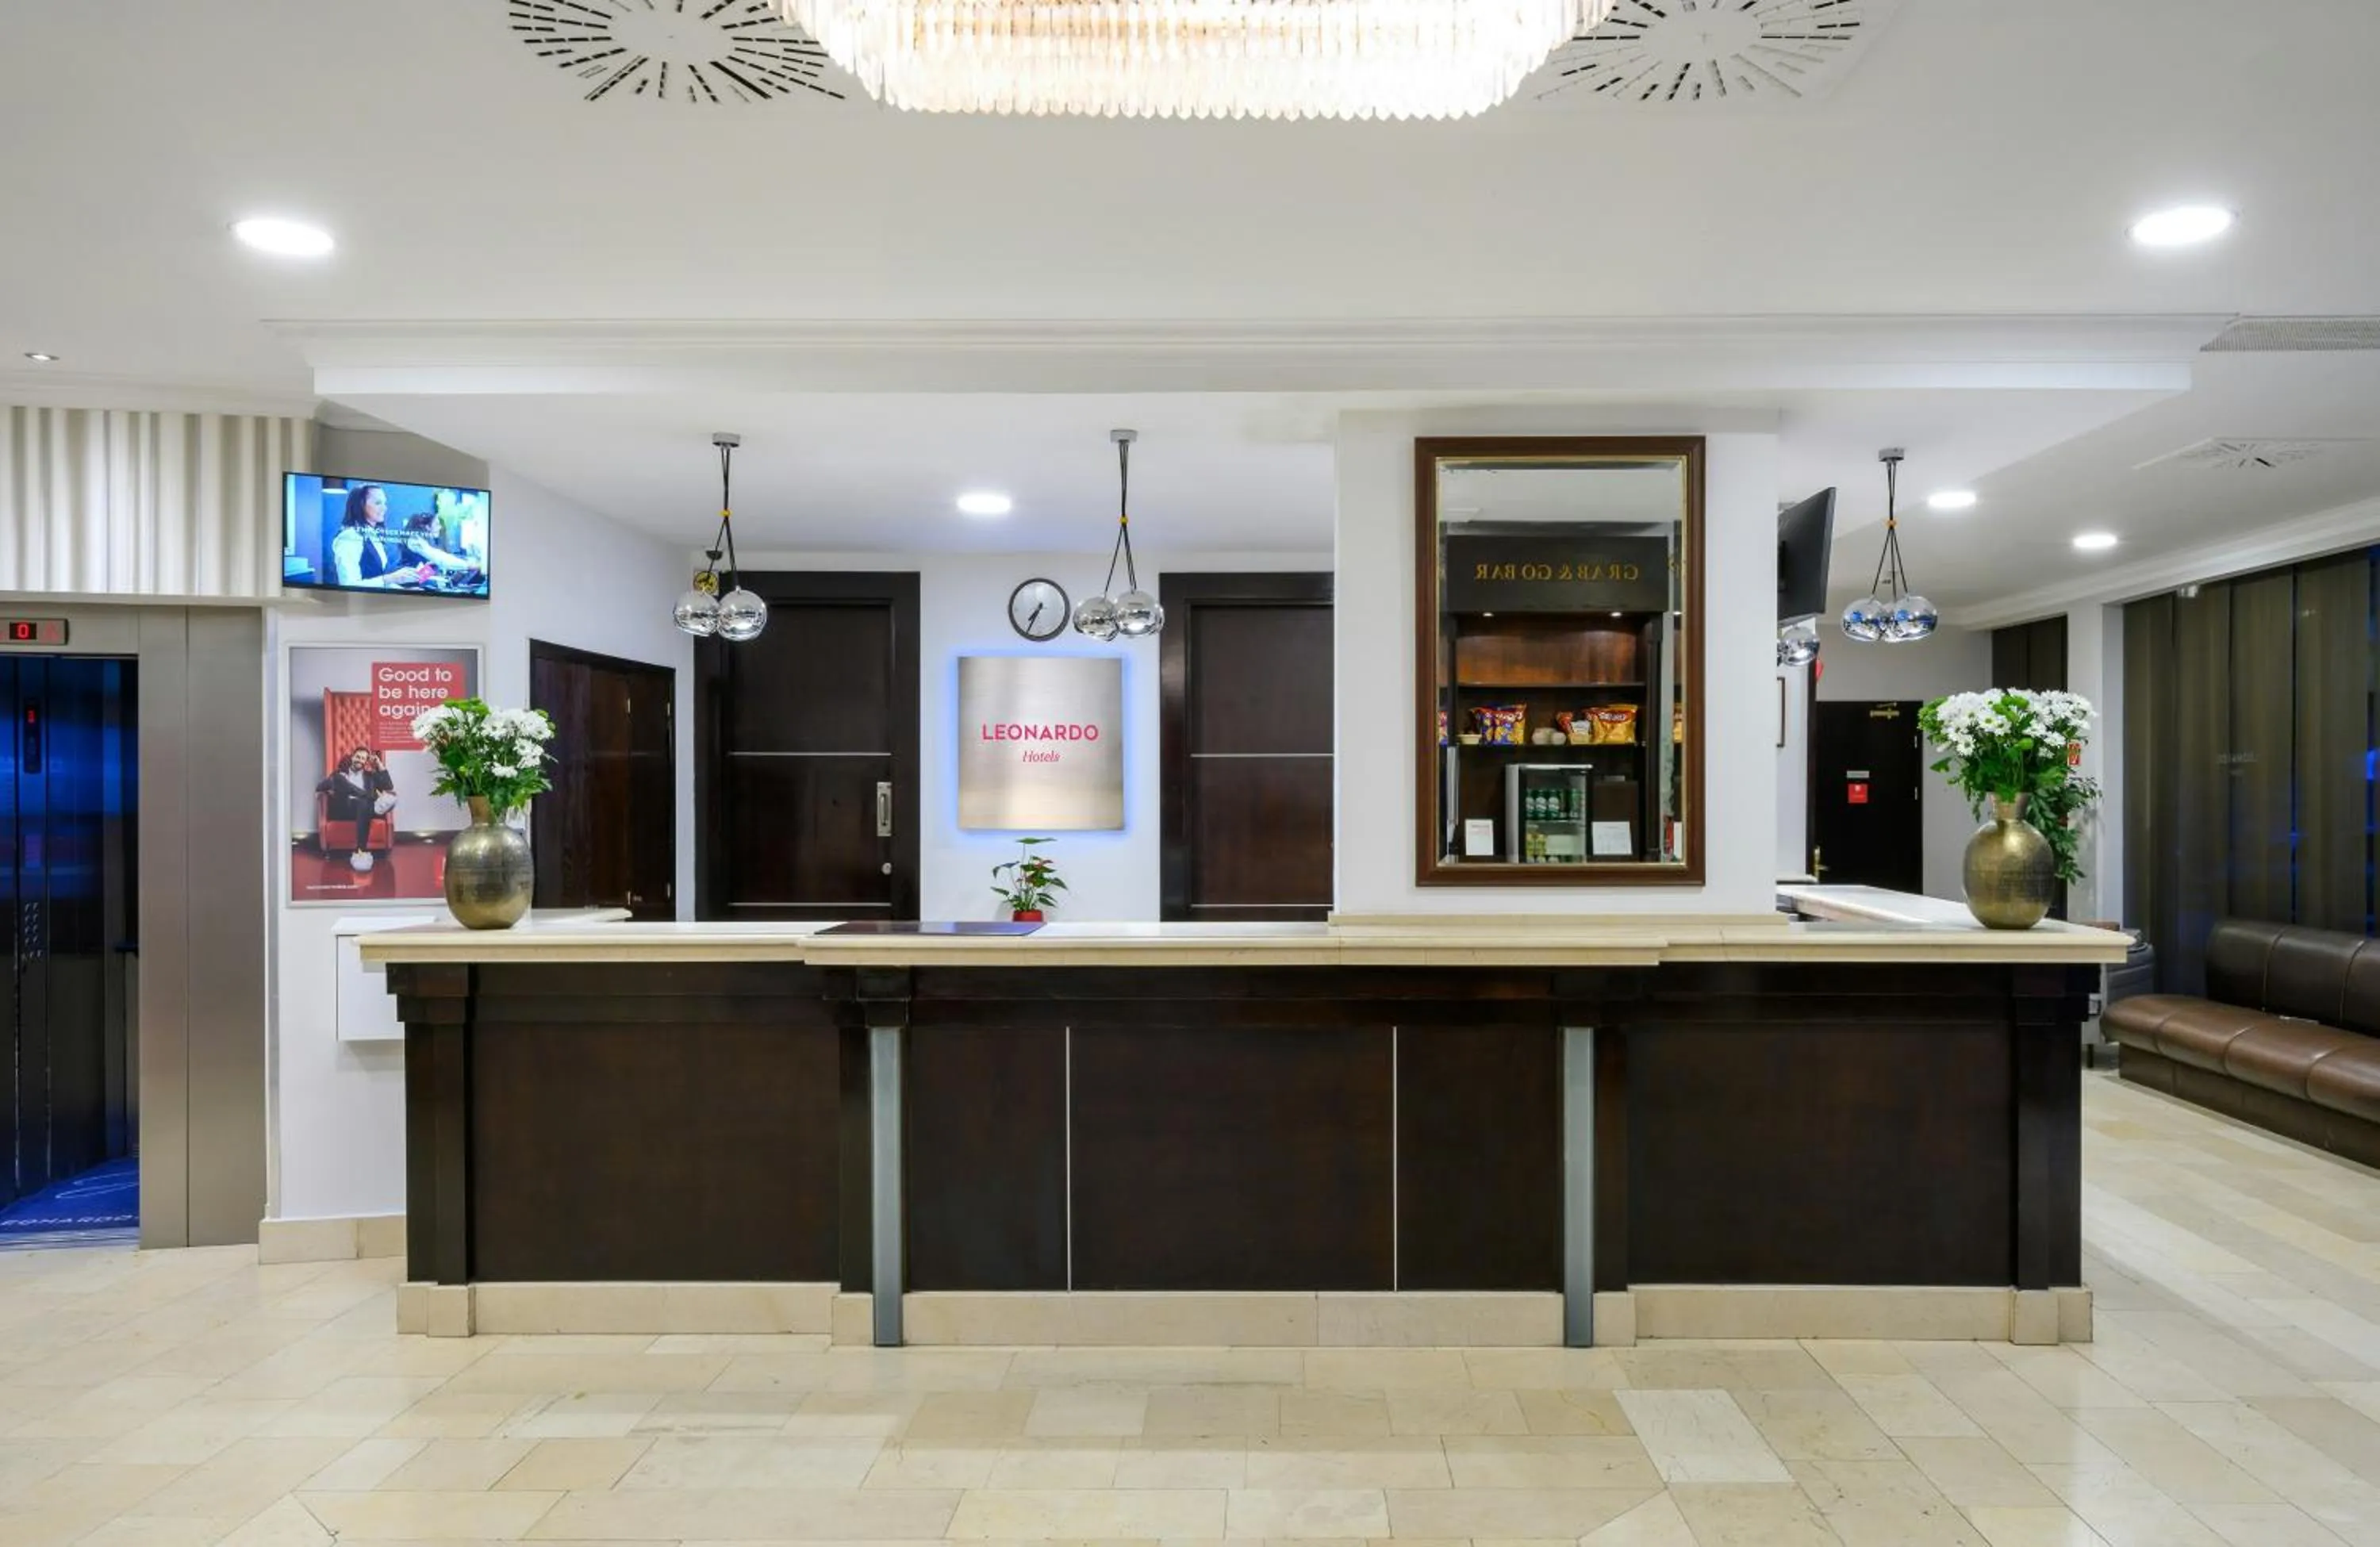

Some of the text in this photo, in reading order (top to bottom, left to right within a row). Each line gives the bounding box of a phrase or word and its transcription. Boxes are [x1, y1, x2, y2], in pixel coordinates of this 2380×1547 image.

[17, 624, 29, 639] 0
[378, 667, 452, 681] Good to
[378, 685, 448, 699] be here
[982, 724, 1099, 741] LEONARDO
[1023, 750, 1061, 762] Hotels
